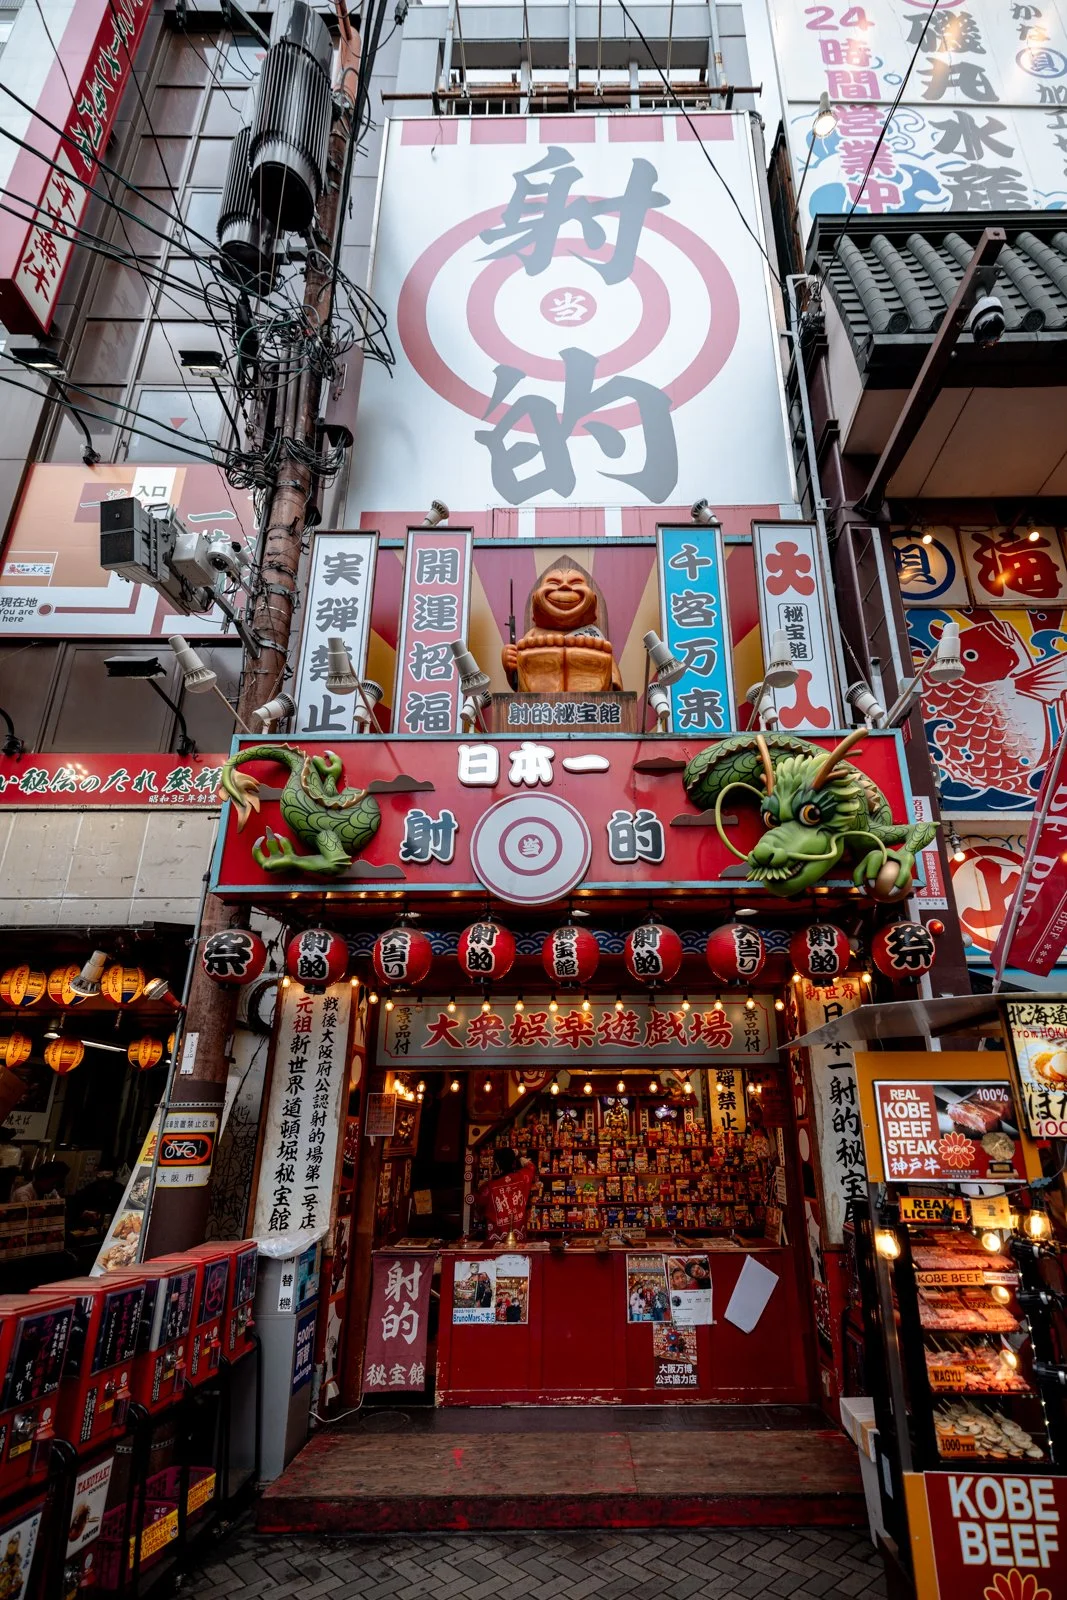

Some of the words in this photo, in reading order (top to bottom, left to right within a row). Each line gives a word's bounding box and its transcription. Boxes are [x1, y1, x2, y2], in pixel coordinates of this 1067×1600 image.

[22, 171, 77, 304] 年中無休
[473, 146, 679, 506] 射的
[550, 292, 589, 323] 当
[136, 485, 167, 498] 入口
[0, 597, 38, 608] 現在地
[404, 548, 461, 733] 開運招福
[669, 543, 724, 730] 千客万来
[784, 606, 808, 659] 秘宝館
[508, 702, 621, 725] 射的秘宝館
[458, 742, 610, 787] 日本一
[148, 794, 217, 803] 昭和35年創業
[204, 931, 252, 975] 祭
[298, 929, 332, 978] 射的
[380, 930, 410, 978] 大当り
[466, 923, 500, 972] 射的
[553, 926, 580, 977] 秘宝館
[632, 925, 663, 975] 射的
[735, 925, 762, 974] 大当り
[808, 925, 838, 974] 射的
[886, 923, 933, 970] 祭
[804, 983, 858, 1000] 新世界
[393, 1007, 413, 1055] 景品付
[421, 1010, 734, 1050] 大衆娯楽遊戯場
[743, 1006, 761, 1053] 景品付
[1008, 1004, 1067, 1026] 北海道
[268, 996, 315, 1232] 元祖新世界道頓堀秘宝館
[298, 996, 339, 1230] 戦後大阪府公認射的場第一号店
[884, 1102, 931, 1118] KOBE
[890, 1089, 920, 1100] REAL
[977, 1088, 1008, 1102] 100%
[888, 1121, 931, 1137] BEEF
[888, 1140, 939, 1155] STEAK
[160, 1173, 194, 1182] 大阪市
[891, 1158, 941, 1175] 神戸牛
[904, 1209, 962, 1219] LICENE
[918, 1273, 948, 1284] KOBE
[951, 1272, 981, 1283] BEEF
[381, 1260, 423, 1345] 射的
[365, 1362, 425, 1387] 秘宝館
[656, 1375, 697, 1384] 公式協力店
[659, 1364, 693, 1374] 大阪万博
[933, 1369, 961, 1382] WAGYU
[948, 1475, 1060, 1521] KOBE
[958, 1521, 1060, 1568] BEEF
